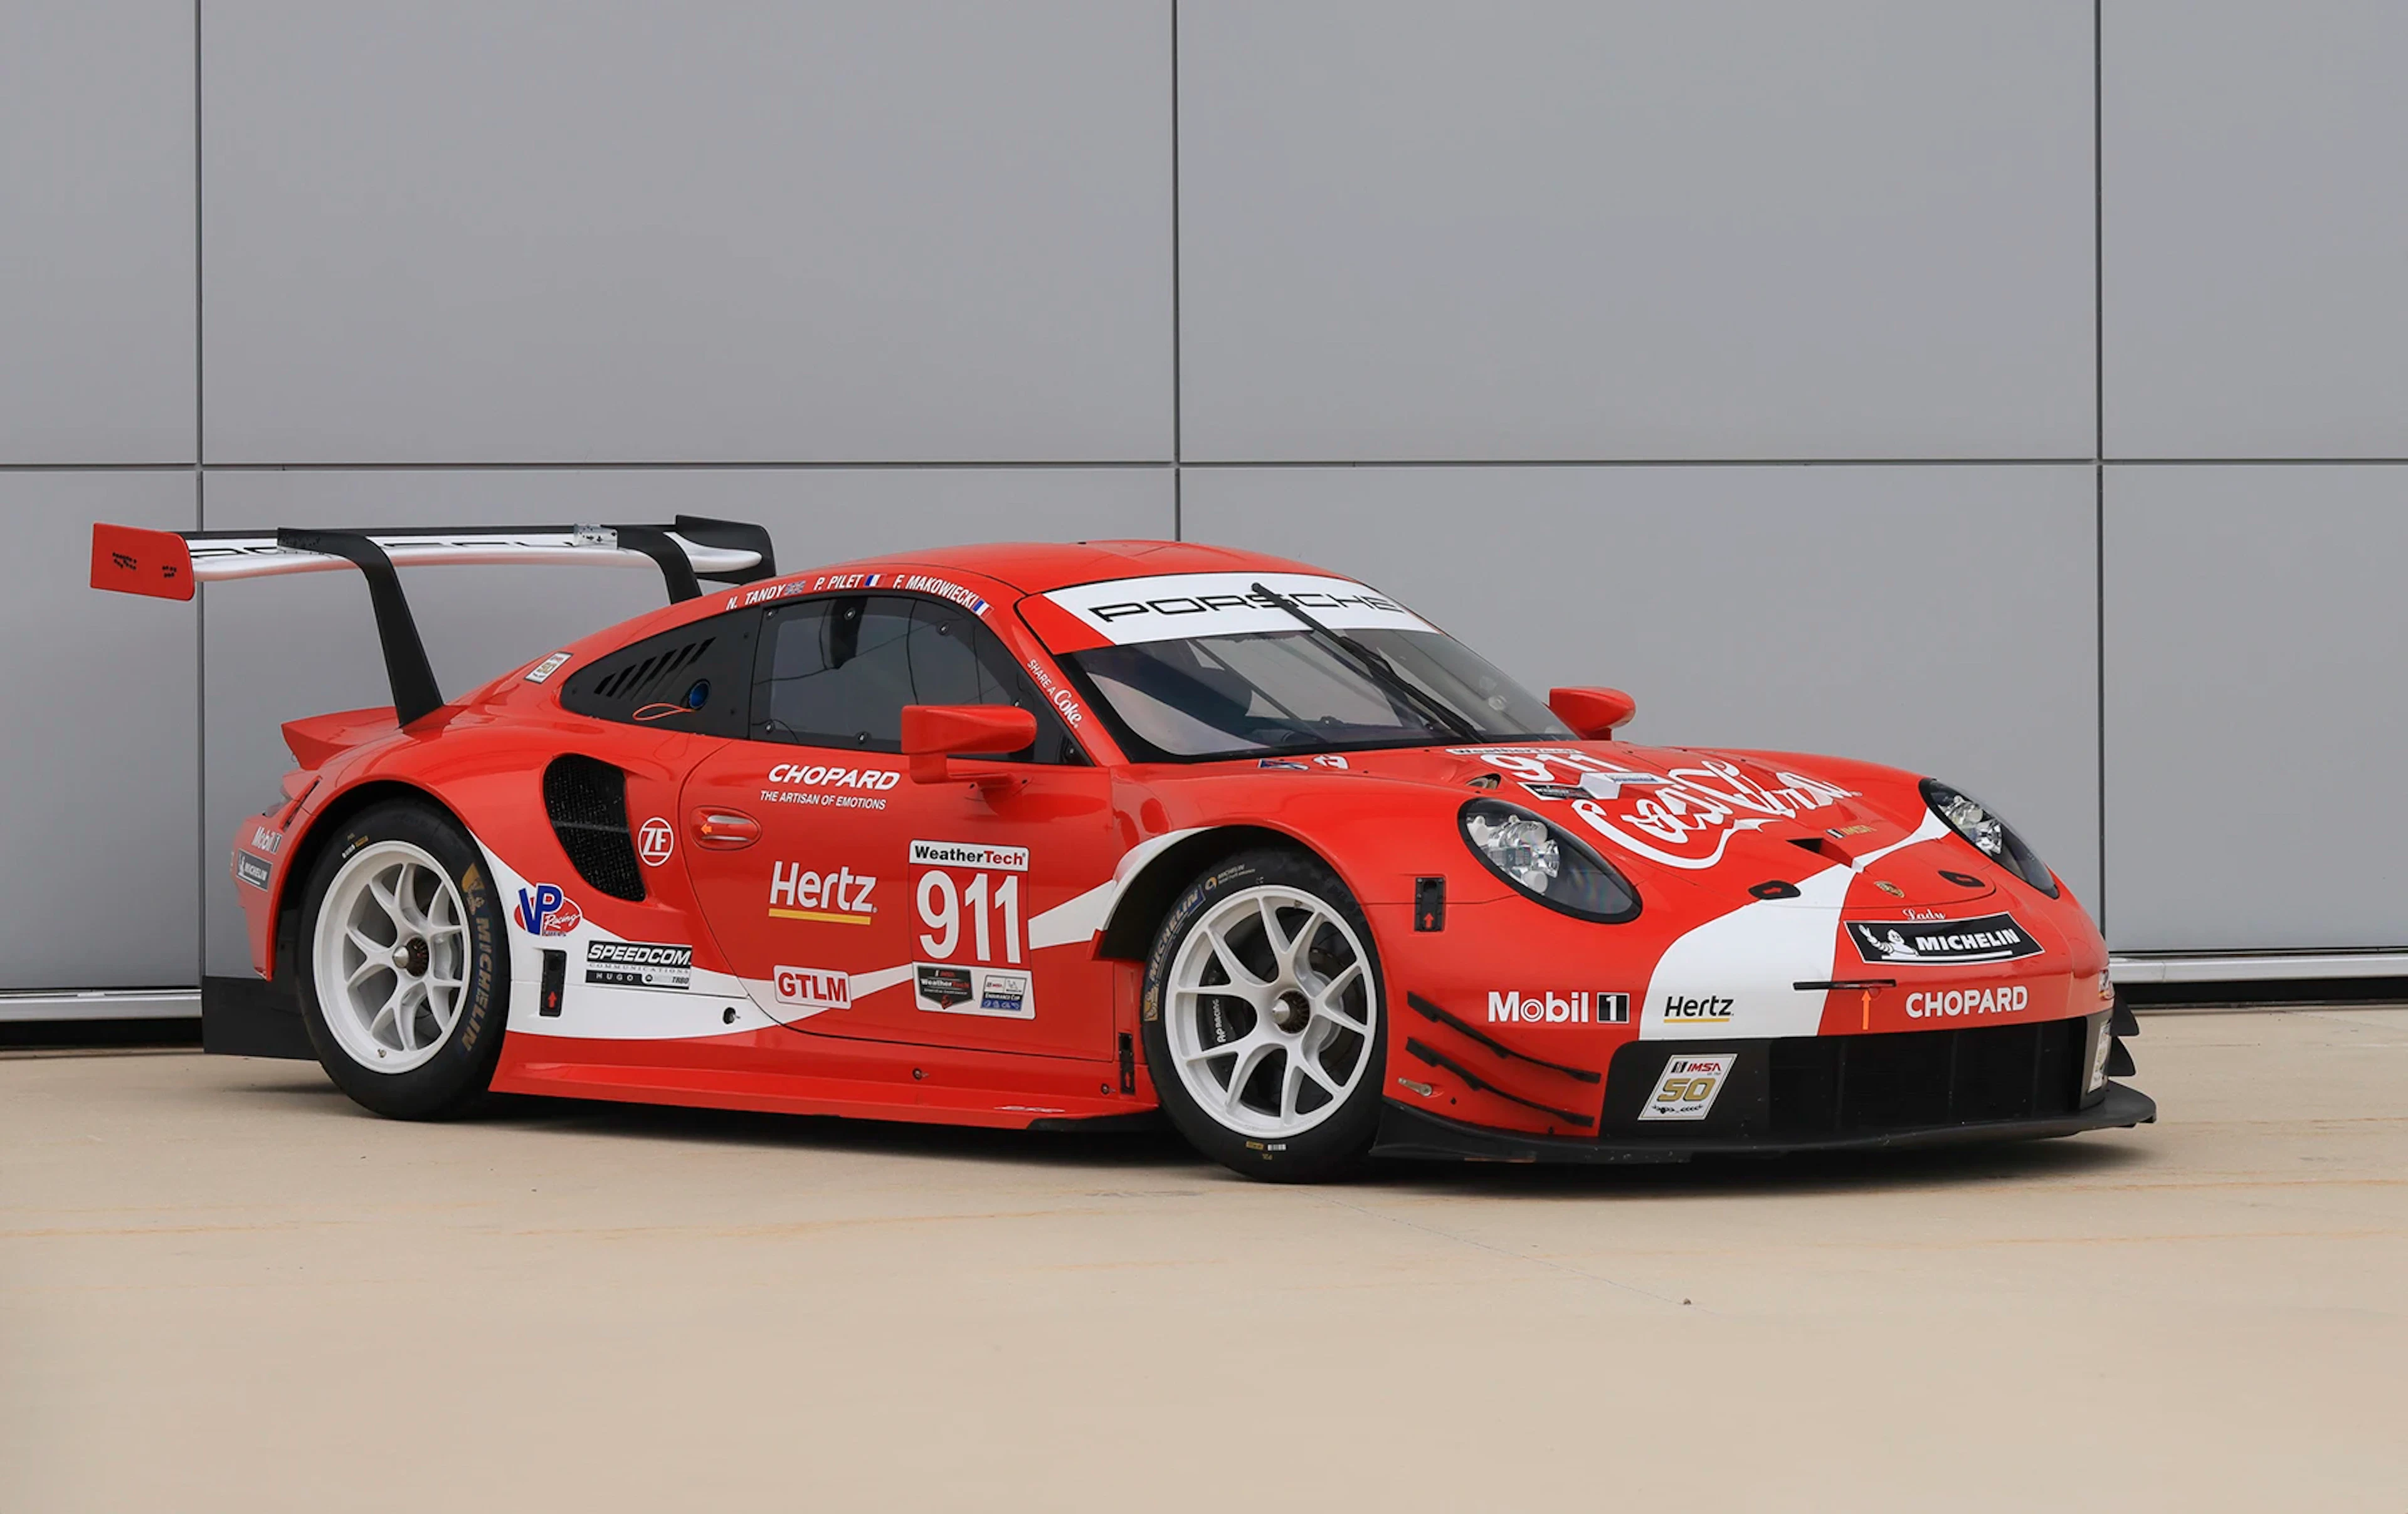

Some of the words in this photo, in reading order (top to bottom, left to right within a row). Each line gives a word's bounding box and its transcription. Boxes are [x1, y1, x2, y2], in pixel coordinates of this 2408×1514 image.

[813, 576, 825, 591] P.
[826, 574, 864, 590] PILET
[892, 574, 905, 589] F.
[905, 575, 980, 609] MAKOWIECKI
[726, 596, 739, 611] N.
[744, 584, 786, 605] TANDY
[1027, 659, 1052, 688] SHARE
[1047, 686, 1056, 696] A
[768, 764, 900, 790] CHOPARD
[1480, 754, 1633, 782] 911
[760, 790, 779, 802] THE
[779, 792, 819, 805] ARTISAN
[820, 794, 835, 806] OF
[835, 796, 887, 810] EMOTIONS
[640, 825, 672, 858] ZF
[769, 861, 877, 913] Hertz
[518, 885, 562, 935] VP
[544, 912, 581, 931] Racing
[917, 870, 1021, 964] 911
[1902, 908, 1946, 921] Lady
[1915, 928, 2021, 951] MICHELIN
[462, 917, 492, 1052] MICHELIN
[778, 972, 847, 1002] GTLM
[1487, 991, 1589, 1023] Mobil
[1664, 995, 1734, 1017] Hertz
[1906, 986, 2029, 1019] CHOPARD
[1687, 1062, 1721, 1073] IMSA
[1657, 1077, 1716, 1102] 50
